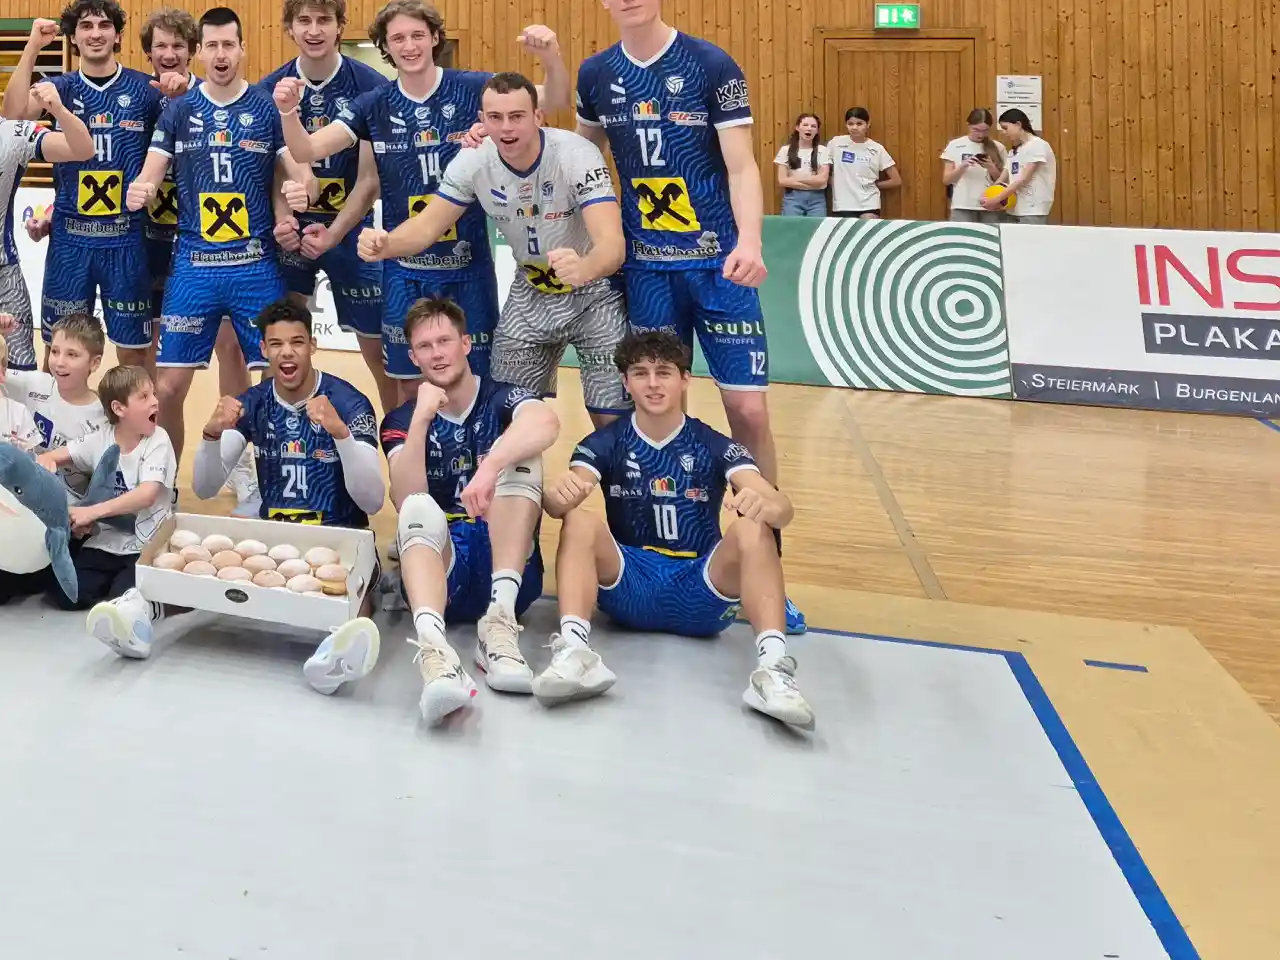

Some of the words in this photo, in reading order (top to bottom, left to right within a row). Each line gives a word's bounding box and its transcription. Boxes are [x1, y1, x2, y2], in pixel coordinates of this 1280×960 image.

[606, 115, 628, 123] HAAS
[92, 133, 113, 161] 41
[635, 128, 666, 167] 12
[210, 152, 234, 183] 15
[418, 152, 442, 185] 14
[191, 250, 262, 263] Hartberg
[108, 299, 152, 312] teubl
[314, 322, 333, 335] RK
[704, 320, 763, 335] teubl
[750, 351, 766, 376] 12
[1031, 373, 1140, 395] STEIERMARK
[53, 435, 68, 447] HA
[281, 465, 308, 499] 24
[427, 469, 444, 477] AAS
[652, 504, 679, 540] 10
